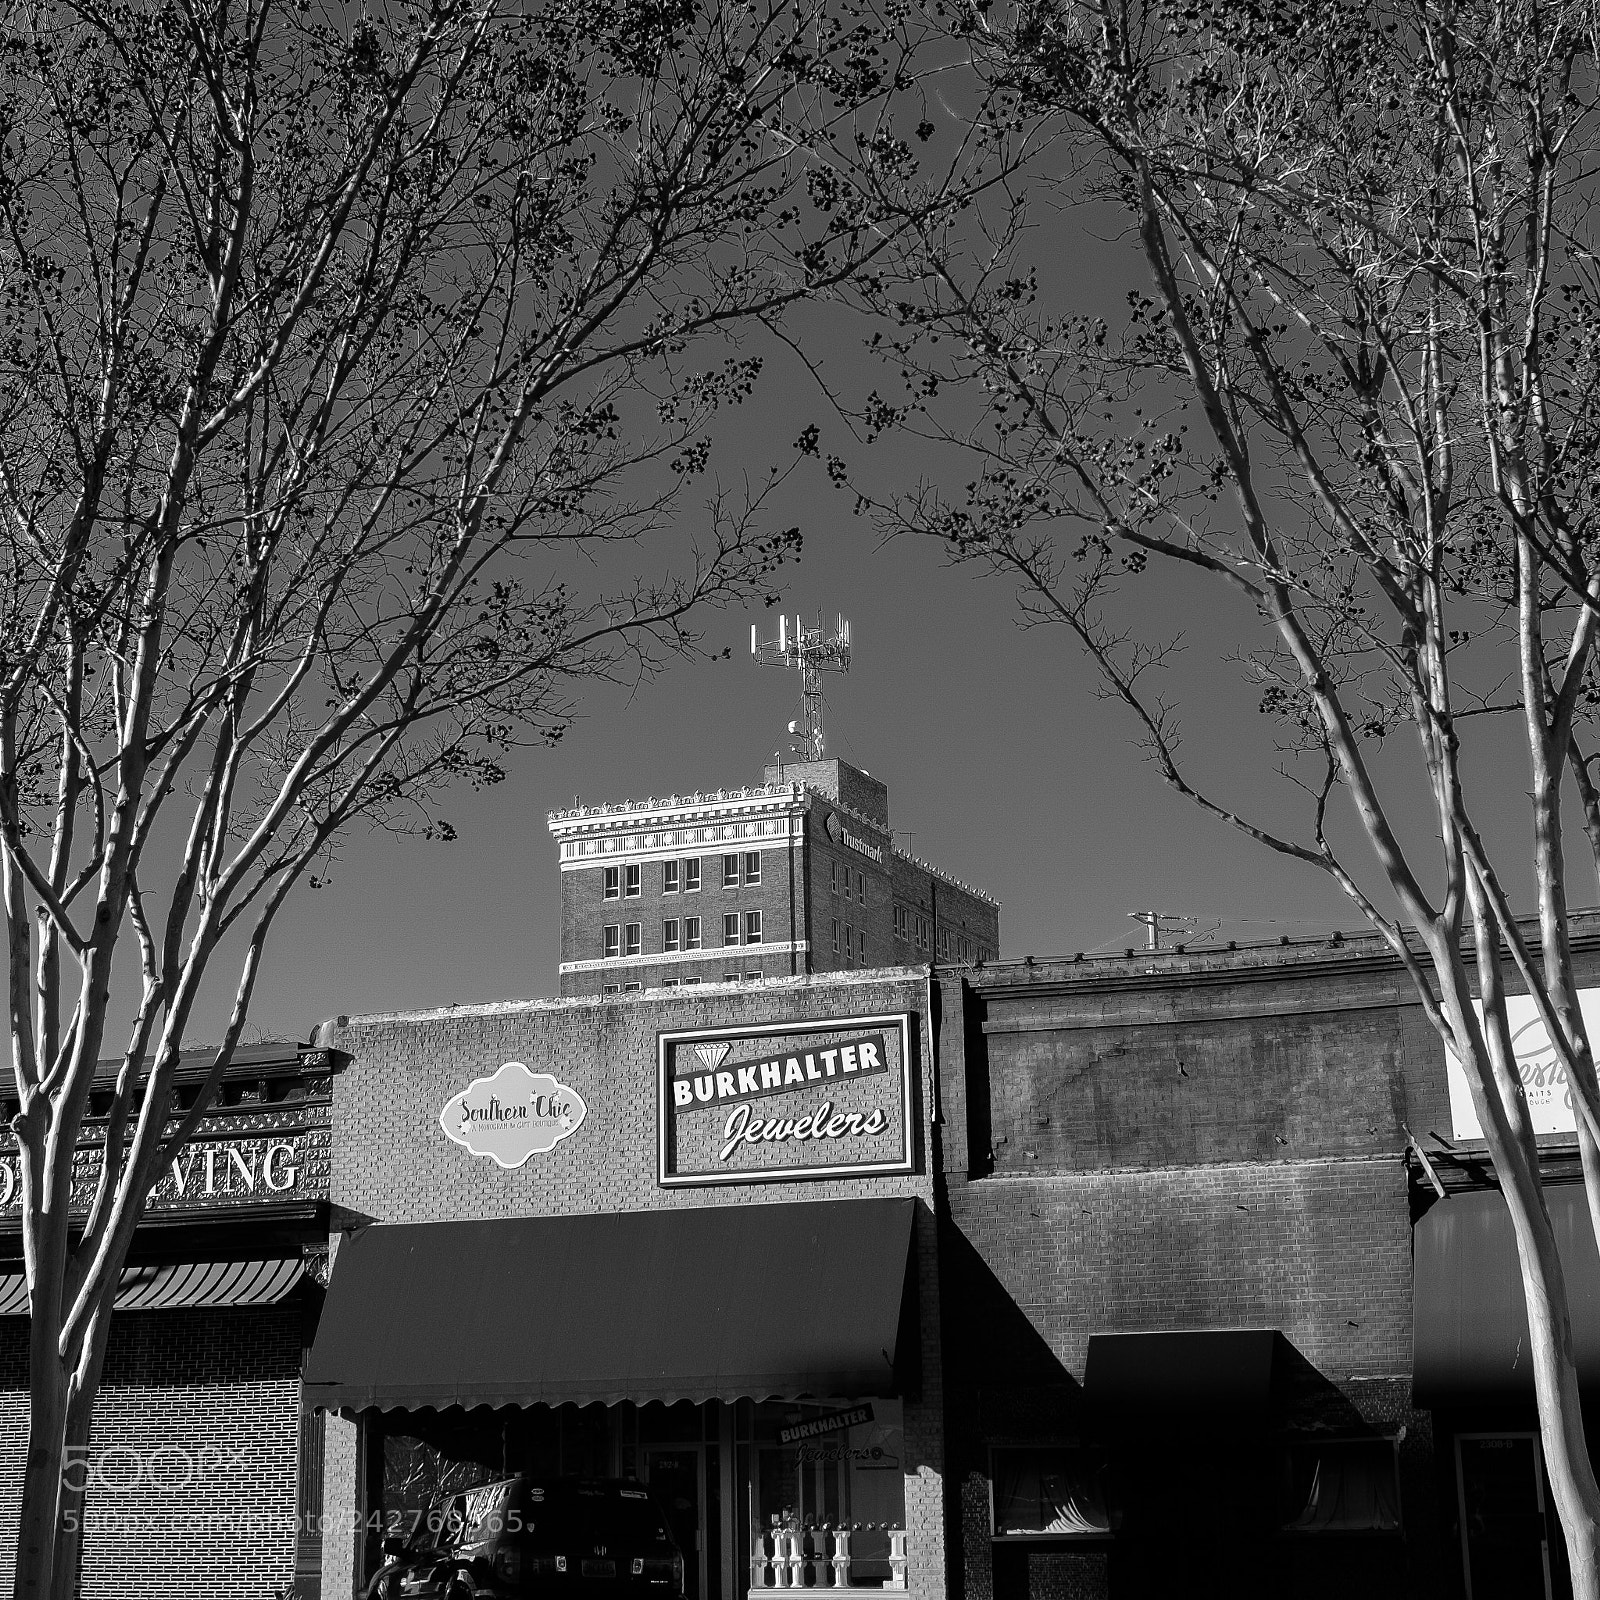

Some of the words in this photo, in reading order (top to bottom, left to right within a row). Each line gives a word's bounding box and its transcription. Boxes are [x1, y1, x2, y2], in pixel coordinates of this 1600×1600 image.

[841, 827, 882, 864] Trustmark
[673, 1042, 882, 1107] BURKHALTER
[462, 1100, 528, 1121] Southern
[535, 1095, 572, 1118] Chic
[719, 1101, 887, 1161] Jewelers
[781, 1409, 868, 1443] BURKHALTER
[792, 1443, 870, 1473] Jewelers
